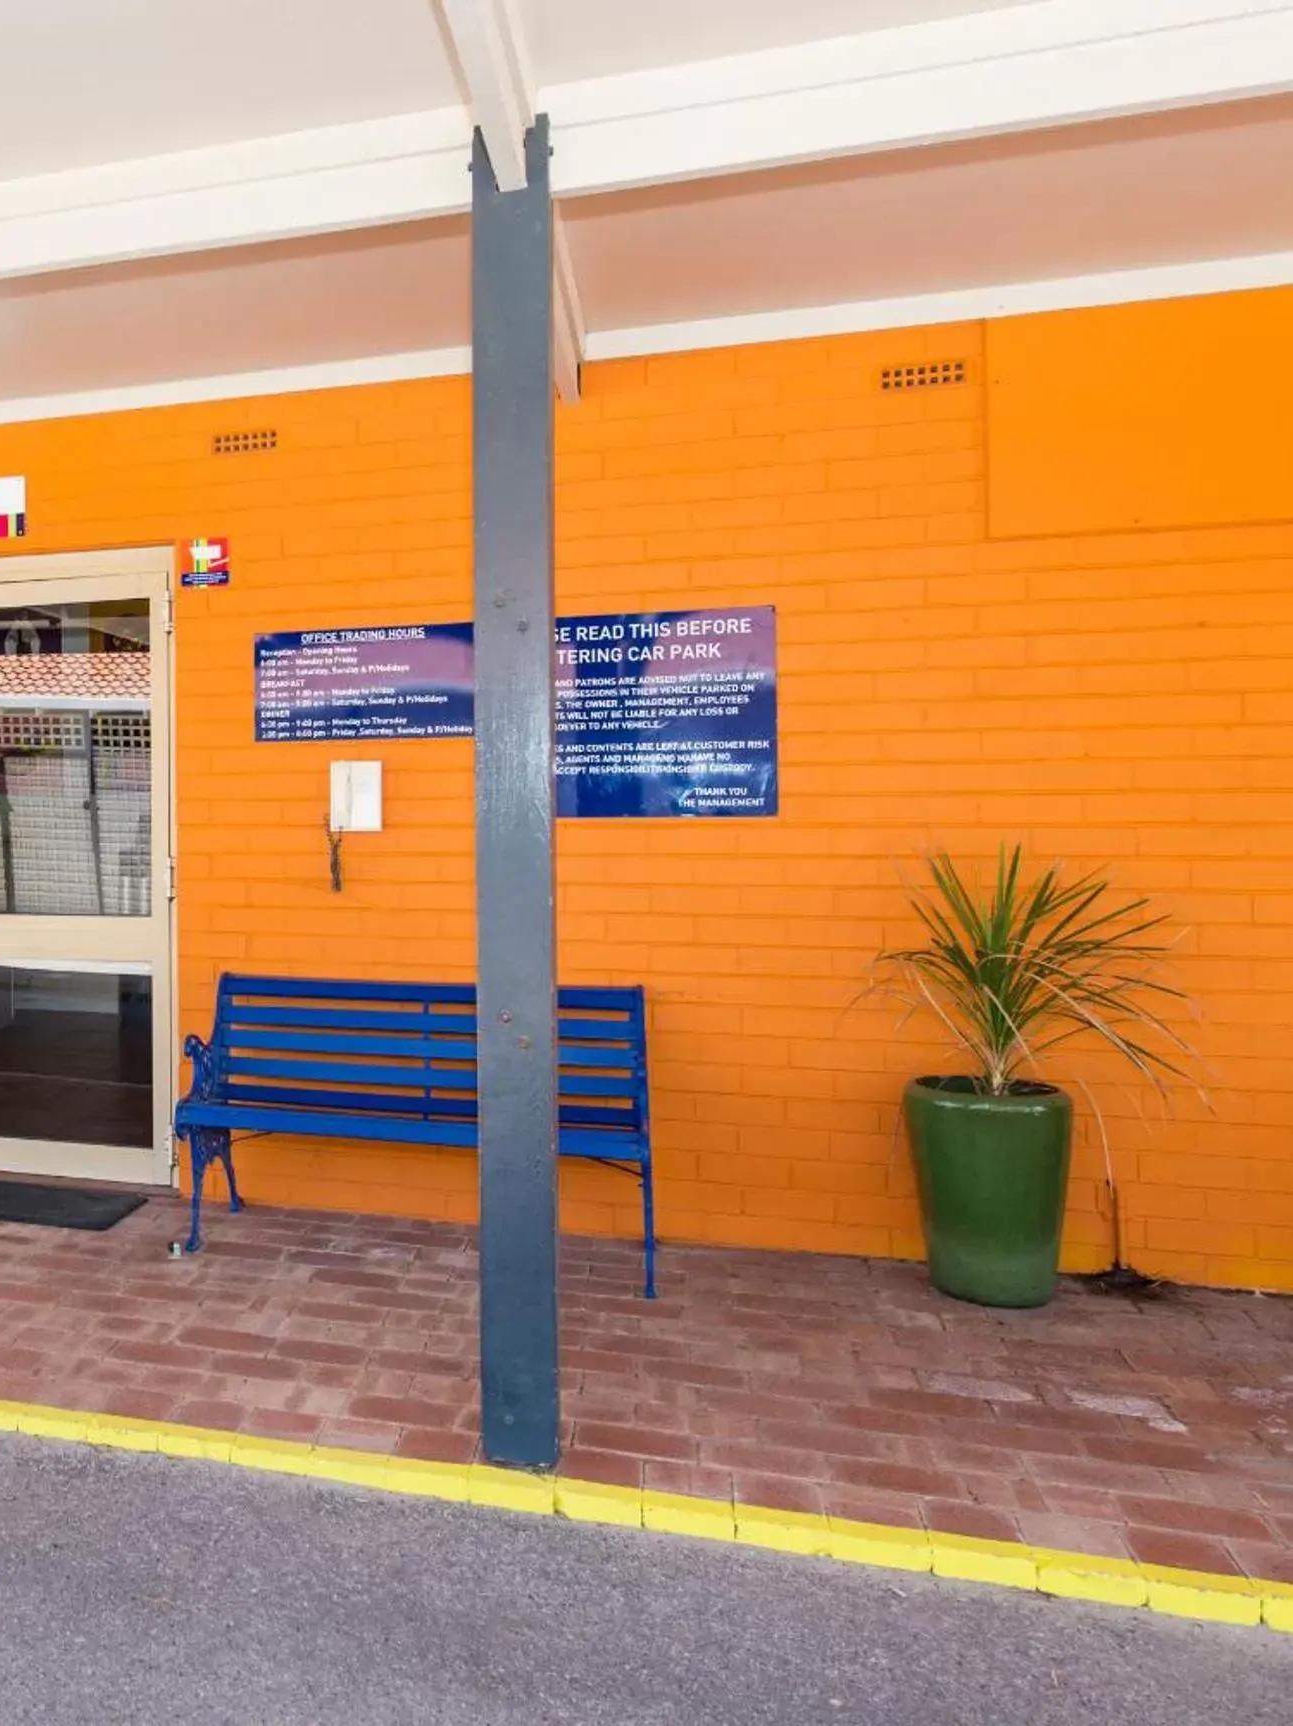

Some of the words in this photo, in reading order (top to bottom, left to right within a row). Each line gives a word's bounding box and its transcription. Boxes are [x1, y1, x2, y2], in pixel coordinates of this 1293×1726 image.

[300, 632, 338, 643] OFFICE
[341, 629, 386, 642] TRADING
[389, 627, 425, 639] HOURS
[576, 625, 624, 641] READ
[629, 622, 671, 639] THIS
[676, 617, 752, 637] BEFORE
[556, 648, 623, 665] TERING
[628, 645, 665, 662] CAR
[670, 642, 722, 660] PARK
[295, 657, 323, 667] Monday
[575, 678, 616, 687] PATRONS
[618, 677, 636, 685] ARE
[638, 675, 677, 684] ADVISED
[679, 674, 698, 682] NOT
[699, 673, 712, 682] TO
[714, 672, 743, 682] LEAVE
[746, 672, 765, 680] ANY
[556, 688, 617, 698] POSSESSIONS
[620, 688, 630, 696] IN
[631, 687, 657, 696] THEIR
[659, 685, 698, 694] VEHICLE
[700, 684, 738, 693] PARKED
[740, 683, 754, 692] ON
[398, 696, 404, 704] &
[566, 700, 582, 709] THE
[585, 699, 618, 708] OWNER
[694, 694, 750, 705] EMPLOYEES
[567, 711, 588, 720] WILL
[590, 711, 608, 719] NOT
[625, 709, 657, 718] LIABLE
[658, 708, 677, 717] FOR
[679, 708, 698, 716] ANY
[700, 706, 723, 716] LOSS
[725, 706, 739, 715] OR
[332, 718, 361, 727] Monday
[371, 716, 408, 725] Thursday
[588, 721, 600, 730] TO
[602, 721, 621, 730] ANY
[332, 728, 356, 737] Friday
[565, 744, 584, 752] AND
[586, 743, 634, 752] CONTENTS
[636, 742, 654, 751] ARE
[656, 742, 677, 751] LEFT
[694, 740, 745, 750] CUSTOMER
[747, 740, 770, 749] RISK
[566, 755, 600, 764] AGENTS
[602, 754, 621, 763] AND
[717, 752, 731, 761] NO
[695, 787, 727, 796] THANK
[729, 787, 747, 796] YOU
[679, 799, 696, 807] THE
[697, 797, 765, 807] MANAGEMENT
